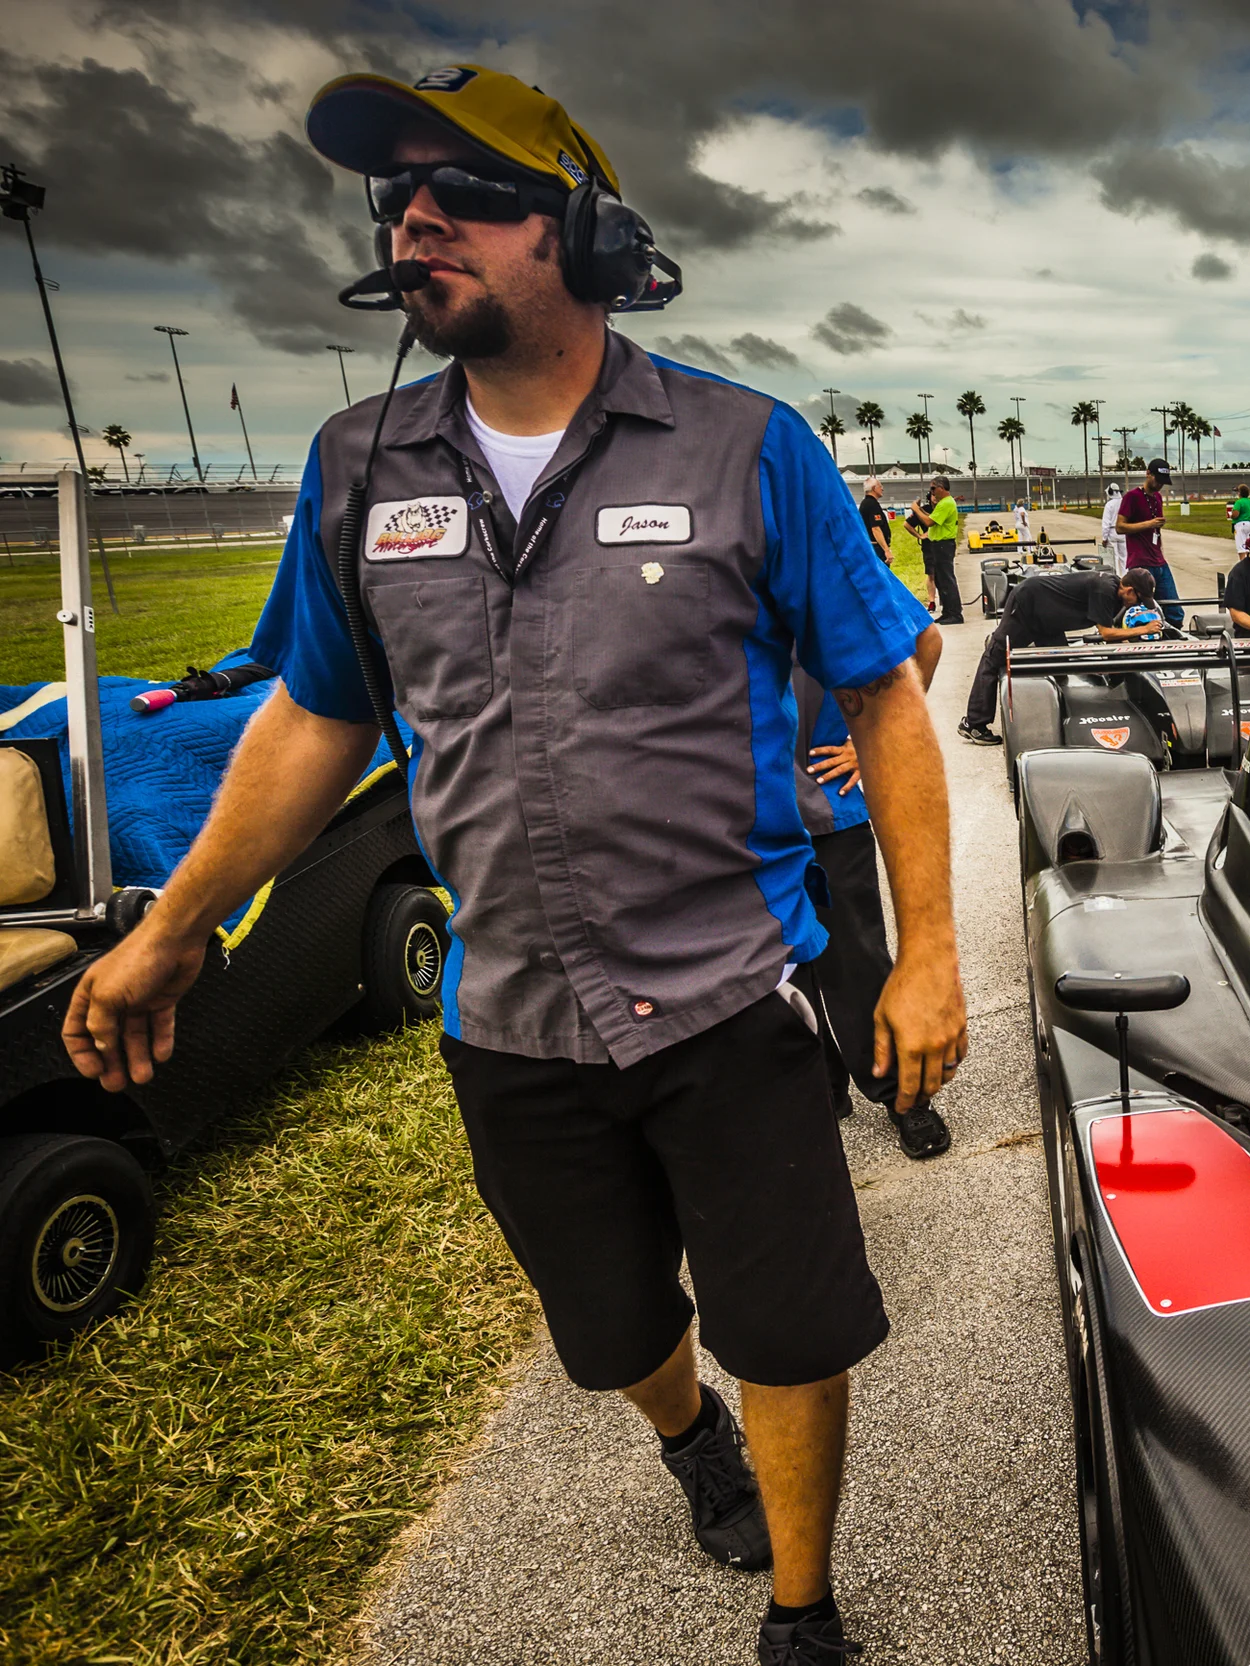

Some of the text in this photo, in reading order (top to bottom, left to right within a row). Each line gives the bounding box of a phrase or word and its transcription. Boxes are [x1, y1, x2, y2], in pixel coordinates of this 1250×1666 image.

[535, 517, 548, 536] Home
[619, 515, 670, 536] Jason
[525, 542, 534, 554] the
[1079, 715, 1131, 725] Hoosier
